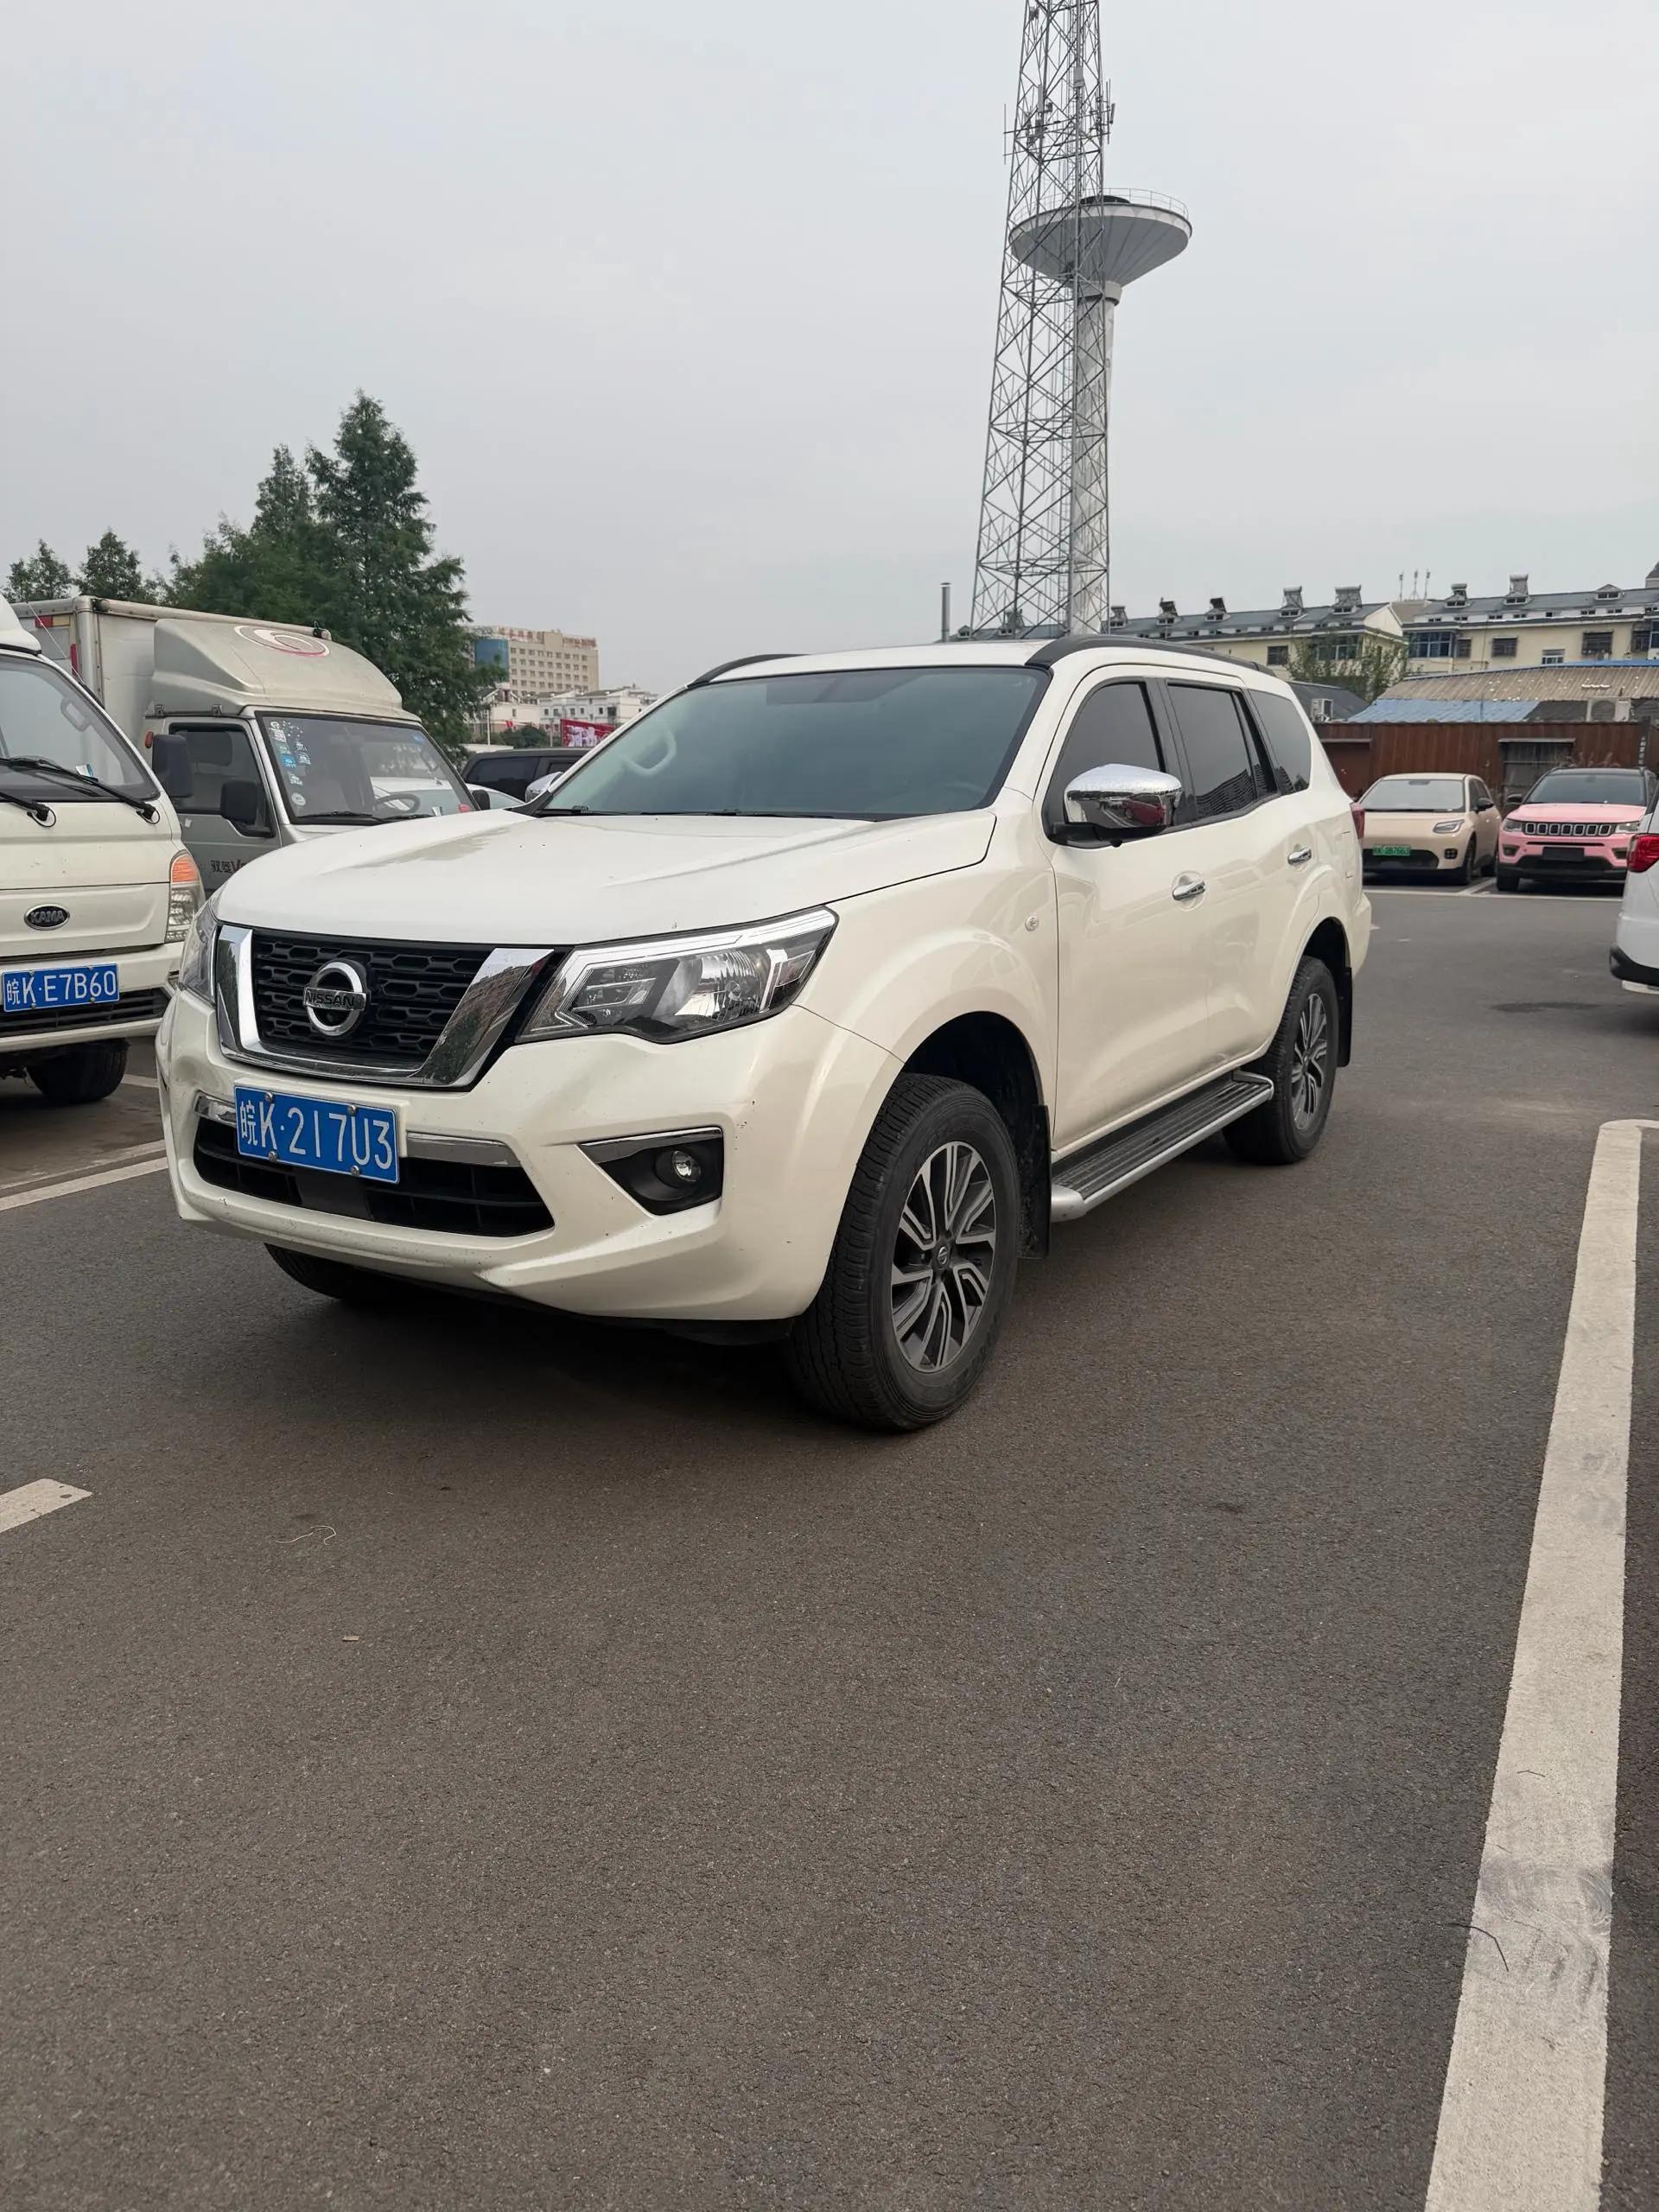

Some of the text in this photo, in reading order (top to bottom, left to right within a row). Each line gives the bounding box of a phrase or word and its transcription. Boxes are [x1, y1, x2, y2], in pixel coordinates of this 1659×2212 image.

[30, 910, 65, 924] KAMA
[6, 970, 117, 1005] 皖K·E7B60
[306, 989, 355, 1007] NISSAN
[240, 1100, 393, 1170] 皖K·217U3
